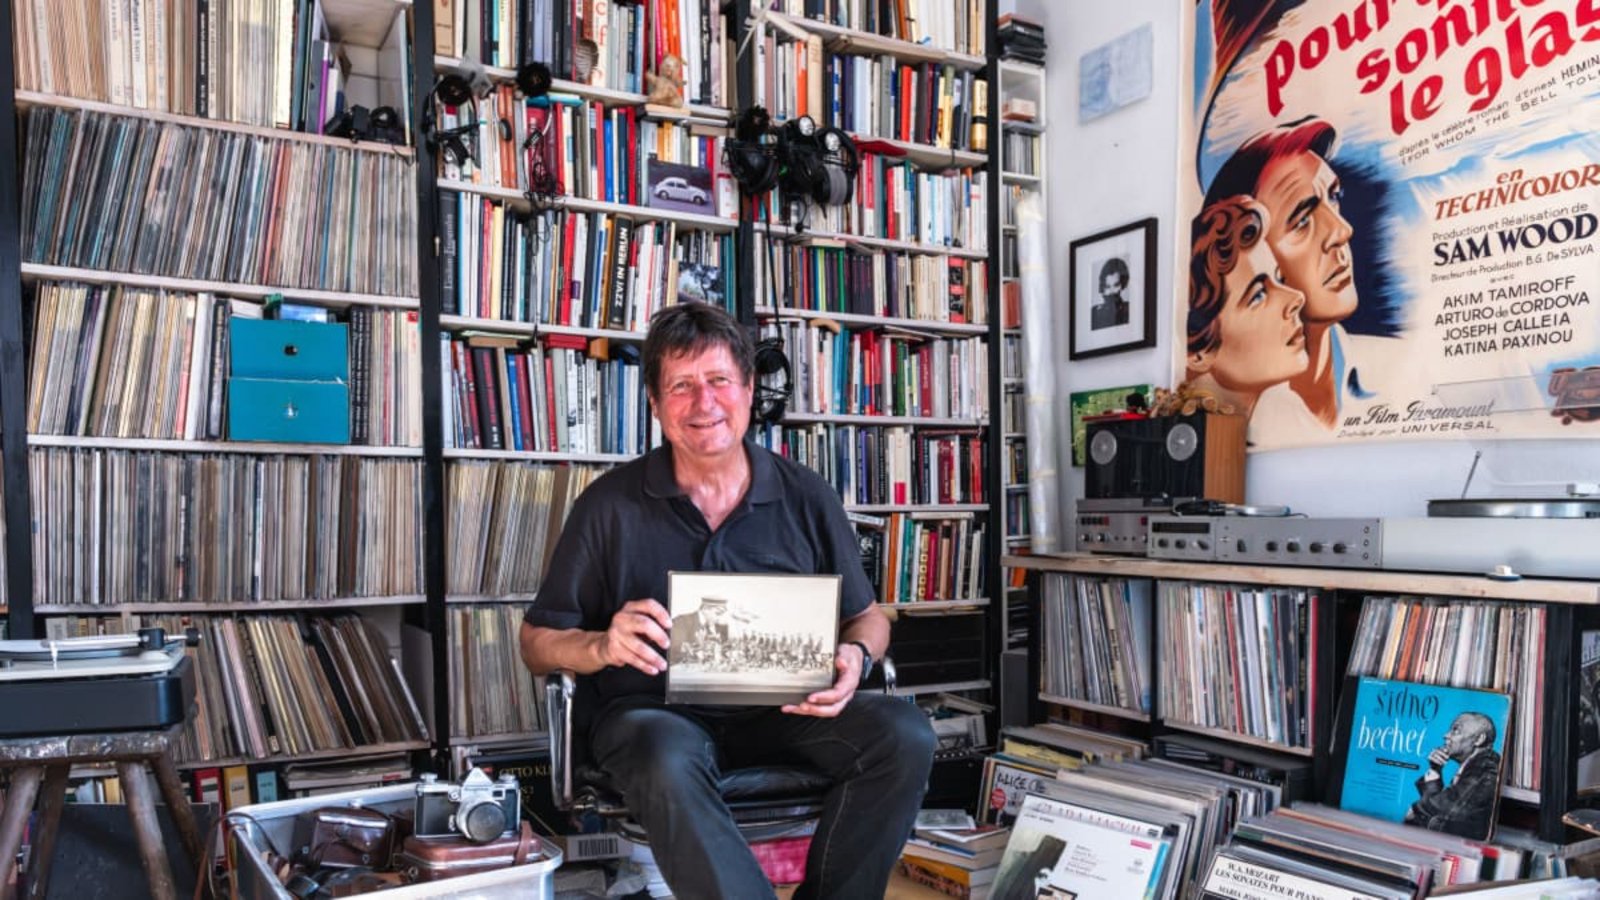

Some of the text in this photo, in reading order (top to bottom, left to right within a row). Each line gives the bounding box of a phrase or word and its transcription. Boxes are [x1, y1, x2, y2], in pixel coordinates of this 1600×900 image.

[1390, 75, 1444, 135] le
[1476, 101, 1509, 121] roman
[1435, 127, 1476, 150] WHOM
[1484, 112, 1510, 127] THE
[1520, 93, 1557, 112] BELL
[1496, 168, 1524, 184] en
[1435, 163, 1600, 221] TECHNICOLOR
[1432, 202, 1589, 242] Production et Réalisation de
[1434, 212, 1598, 267] SAM WOOD
[1466, 266, 1477, 277] de
[1479, 257, 1523, 274] Production
[1489, 273, 1515, 284] avec
[1443, 275, 1576, 309] AKIM TAMIROFF
[1434, 291, 1590, 326] ARTURO de CORDOVA
[1442, 311, 1570, 341] JOSEPH CALLEIA
[1444, 329, 1573, 357] KATINA PAXINOU
[1343, 399, 1495, 427] un Film Paramount
[1402, 420, 1495, 434] UNIVERSAL
[1357, 715, 1428, 757] bechet
[1215, 867, 1230, 878] LES
[1233, 873, 1268, 889] SONATES
[1270, 883, 1295, 898] POUR
[1246, 866, 1280, 883] MOZART
